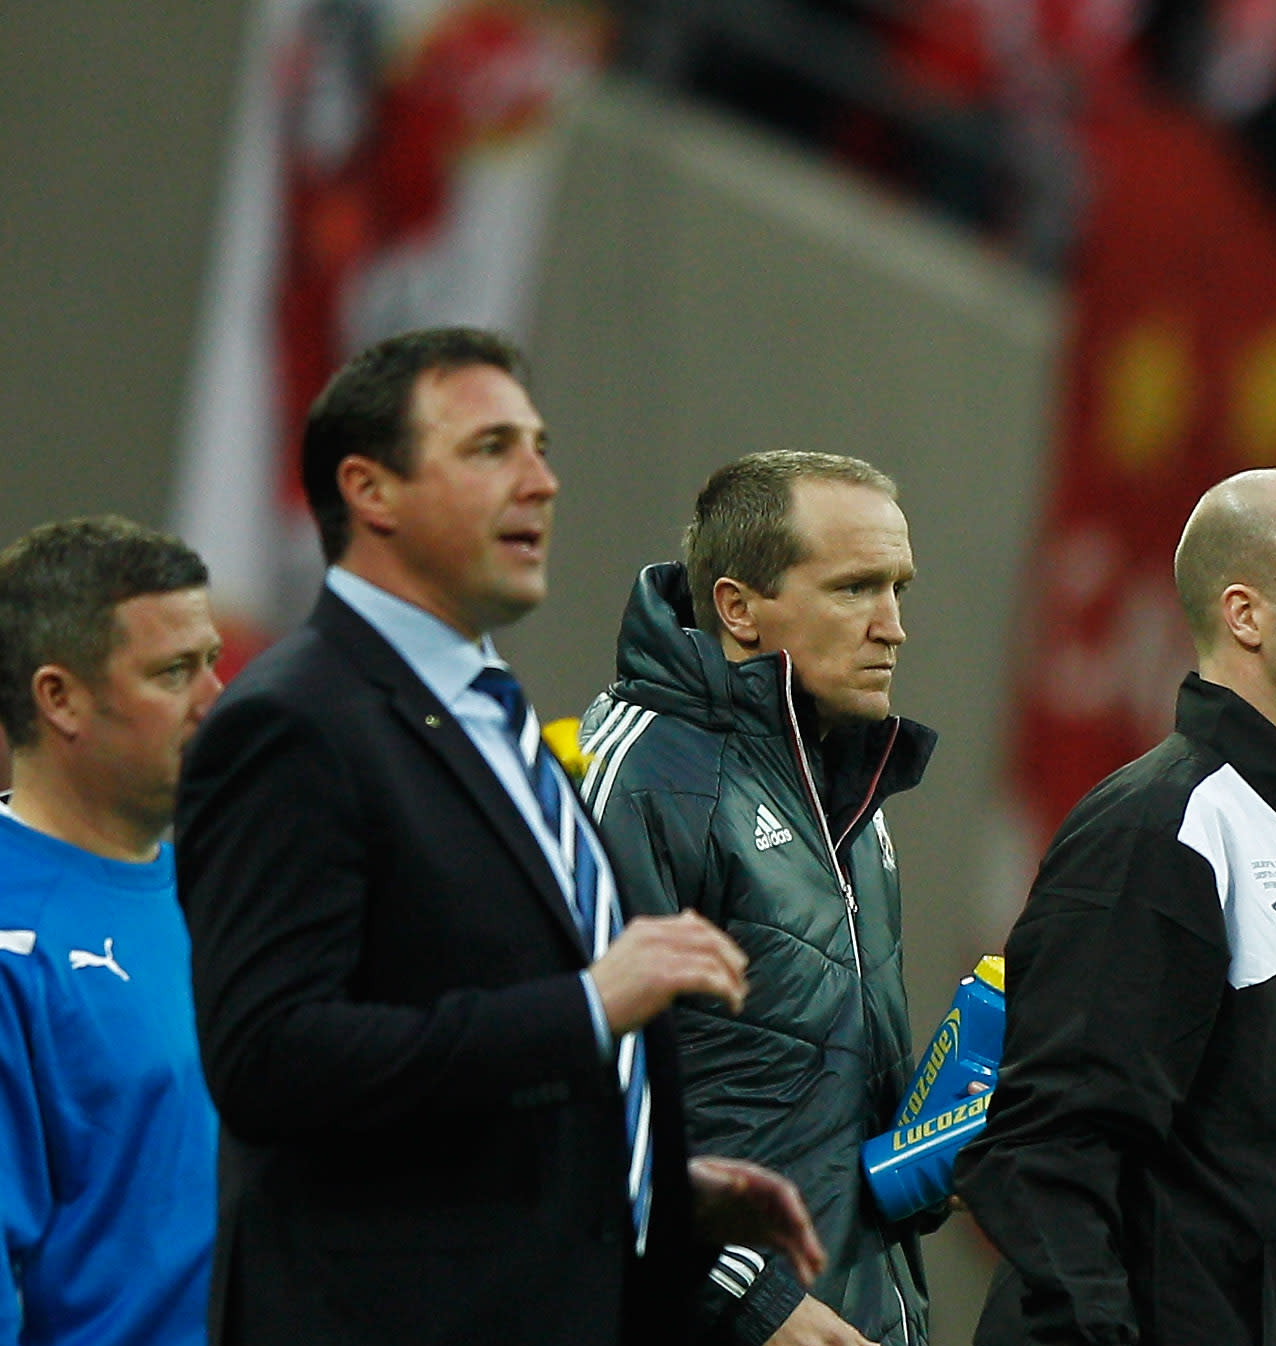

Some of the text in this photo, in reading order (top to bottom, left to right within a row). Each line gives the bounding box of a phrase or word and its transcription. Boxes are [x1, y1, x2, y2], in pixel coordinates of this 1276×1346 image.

[754, 828, 793, 851] adidas
[897, 1029, 952, 1127] cozade
[892, 1092, 994, 1151] Lucoza
